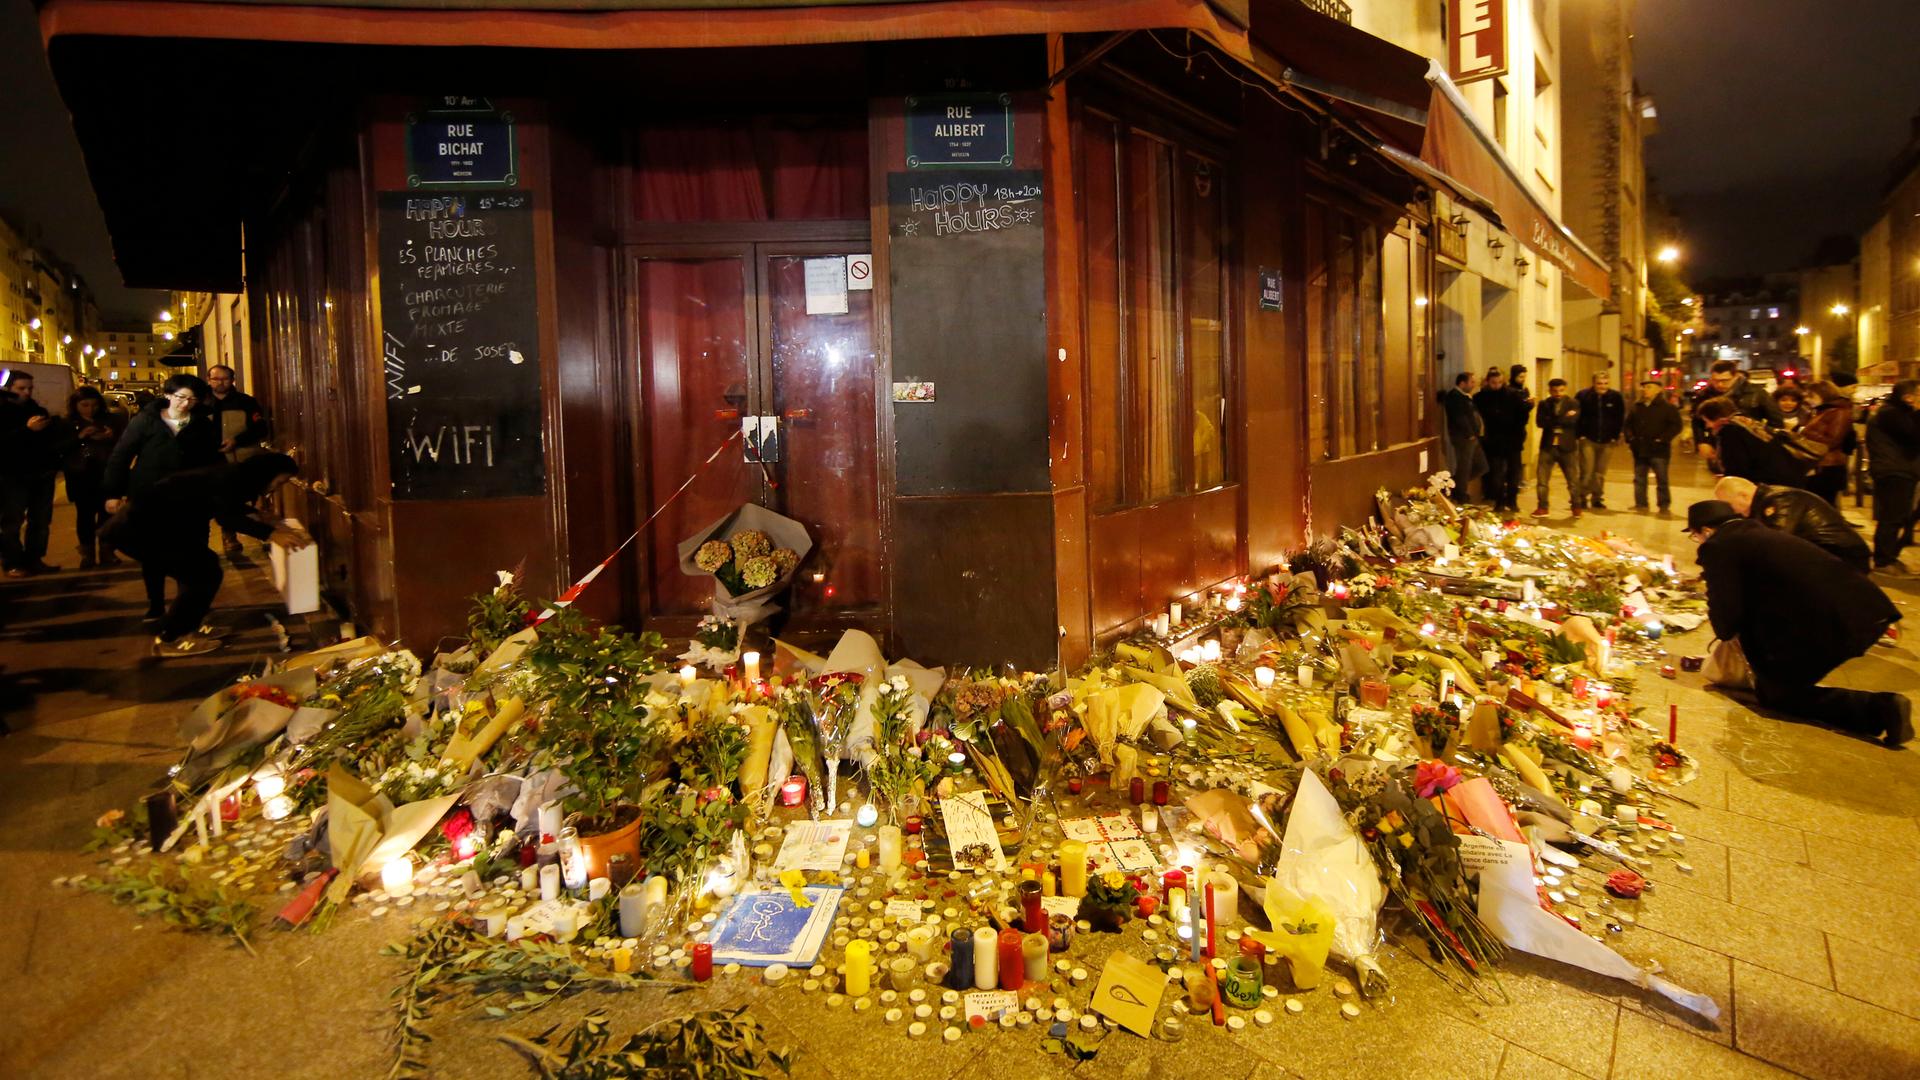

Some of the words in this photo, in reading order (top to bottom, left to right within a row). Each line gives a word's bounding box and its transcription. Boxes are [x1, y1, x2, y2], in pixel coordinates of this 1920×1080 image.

[947, 107, 973, 119] RUE
[447, 124, 474, 137] RUE
[935, 124, 986, 137] ALIBERT
[439, 142, 484, 156] BICHAT
[424, 244, 498, 264] PLANCHES
